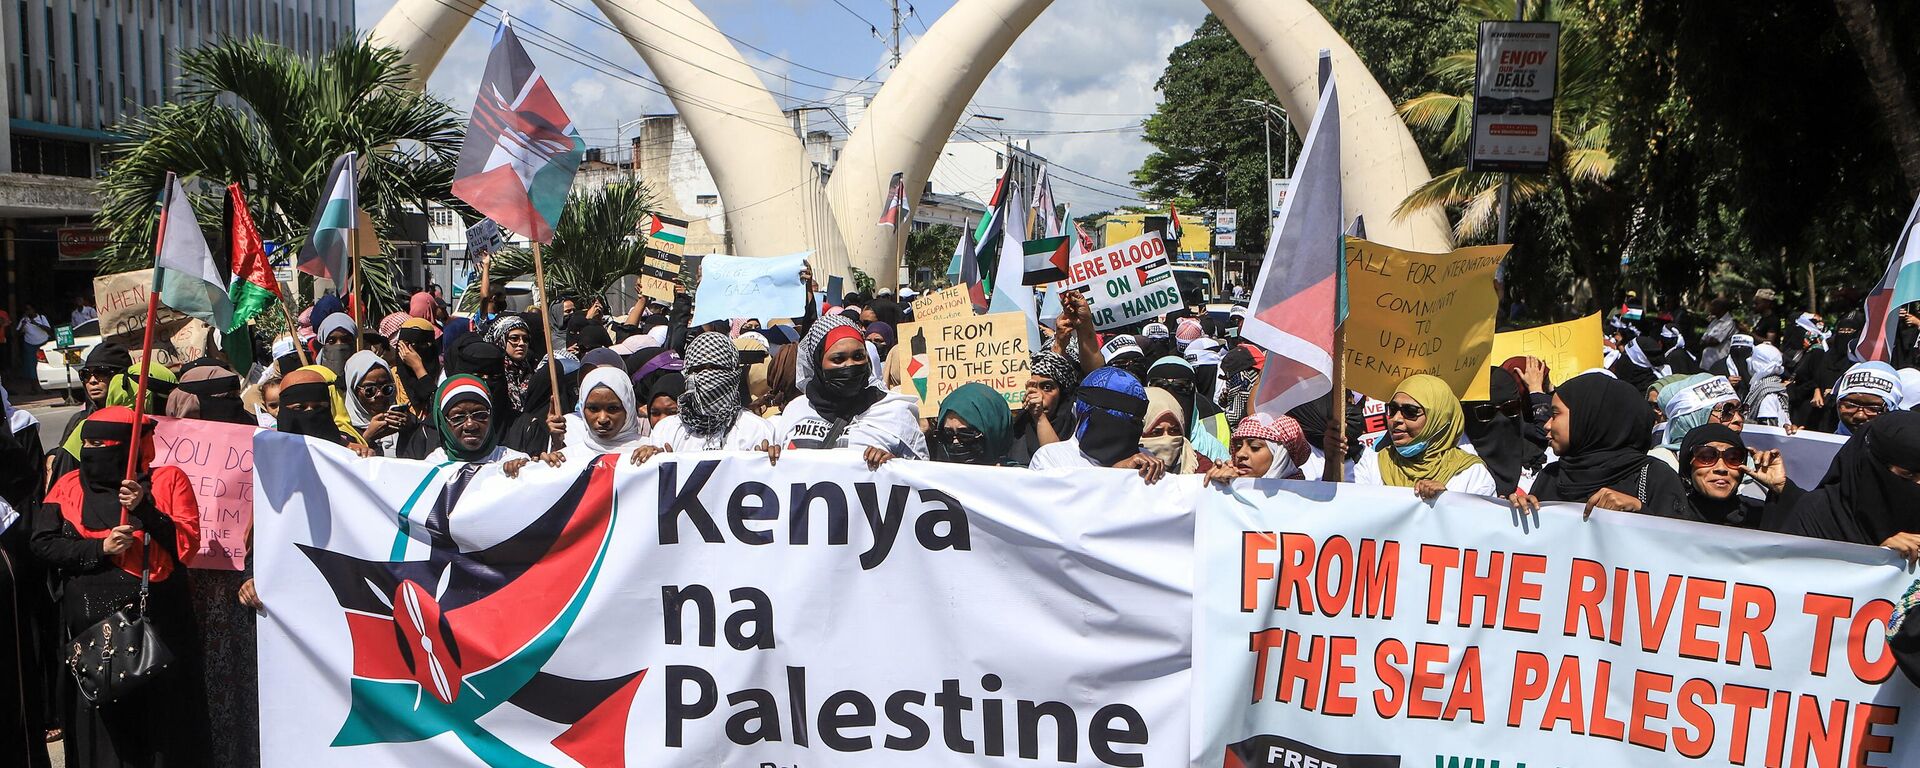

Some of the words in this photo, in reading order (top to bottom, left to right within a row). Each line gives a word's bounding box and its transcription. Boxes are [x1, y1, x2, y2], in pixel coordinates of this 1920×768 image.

[1500, 50, 1548, 68] ENJOY
[1495, 73, 1536, 88] DEALS
[654, 240, 674, 253] STOP
[657, 250, 669, 261] THE
[654, 269, 664, 278] ON
[1057, 256, 1107, 288] HERE
[1107, 236, 1165, 271] BLOOD
[1144, 262, 1157, 270] FREE
[1406, 262, 1436, 285] FOR
[647, 278, 668, 291] GAZA
[1105, 274, 1132, 299] ON
[97, 283, 146, 316] WHEN
[915, 298, 933, 310] END
[940, 288, 959, 300] THE
[1091, 306, 1117, 328] UR
[1121, 285, 1179, 319] HANDS
[1376, 289, 1457, 317] COMMUNITY
[942, 321, 993, 342] FROM
[1416, 320, 1431, 335] TO
[1522, 325, 1572, 353] END
[934, 344, 967, 362] THE
[975, 337, 1025, 359] RIVER
[1379, 329, 1442, 358] UPHOLD
[938, 364, 957, 380] TO
[963, 360, 994, 378] THE
[1000, 359, 1030, 376] SEA
[1454, 355, 1478, 372] LAW
[937, 376, 1017, 396] PATINE
[160, 436, 211, 466] YOU
[658, 460, 971, 570] Kenya
[223, 547, 244, 558] BE
[661, 583, 775, 650] na
[1240, 531, 1400, 620] FROM
[1419, 543, 1548, 634] THE
[1563, 557, 1776, 670] RIVER
[1803, 591, 1897, 685] TO
[1249, 628, 1358, 717] THE
[1373, 637, 1486, 724] SEA
[1506, 650, 1901, 768] PALESTINE
[664, 664, 1149, 767] Palestine
